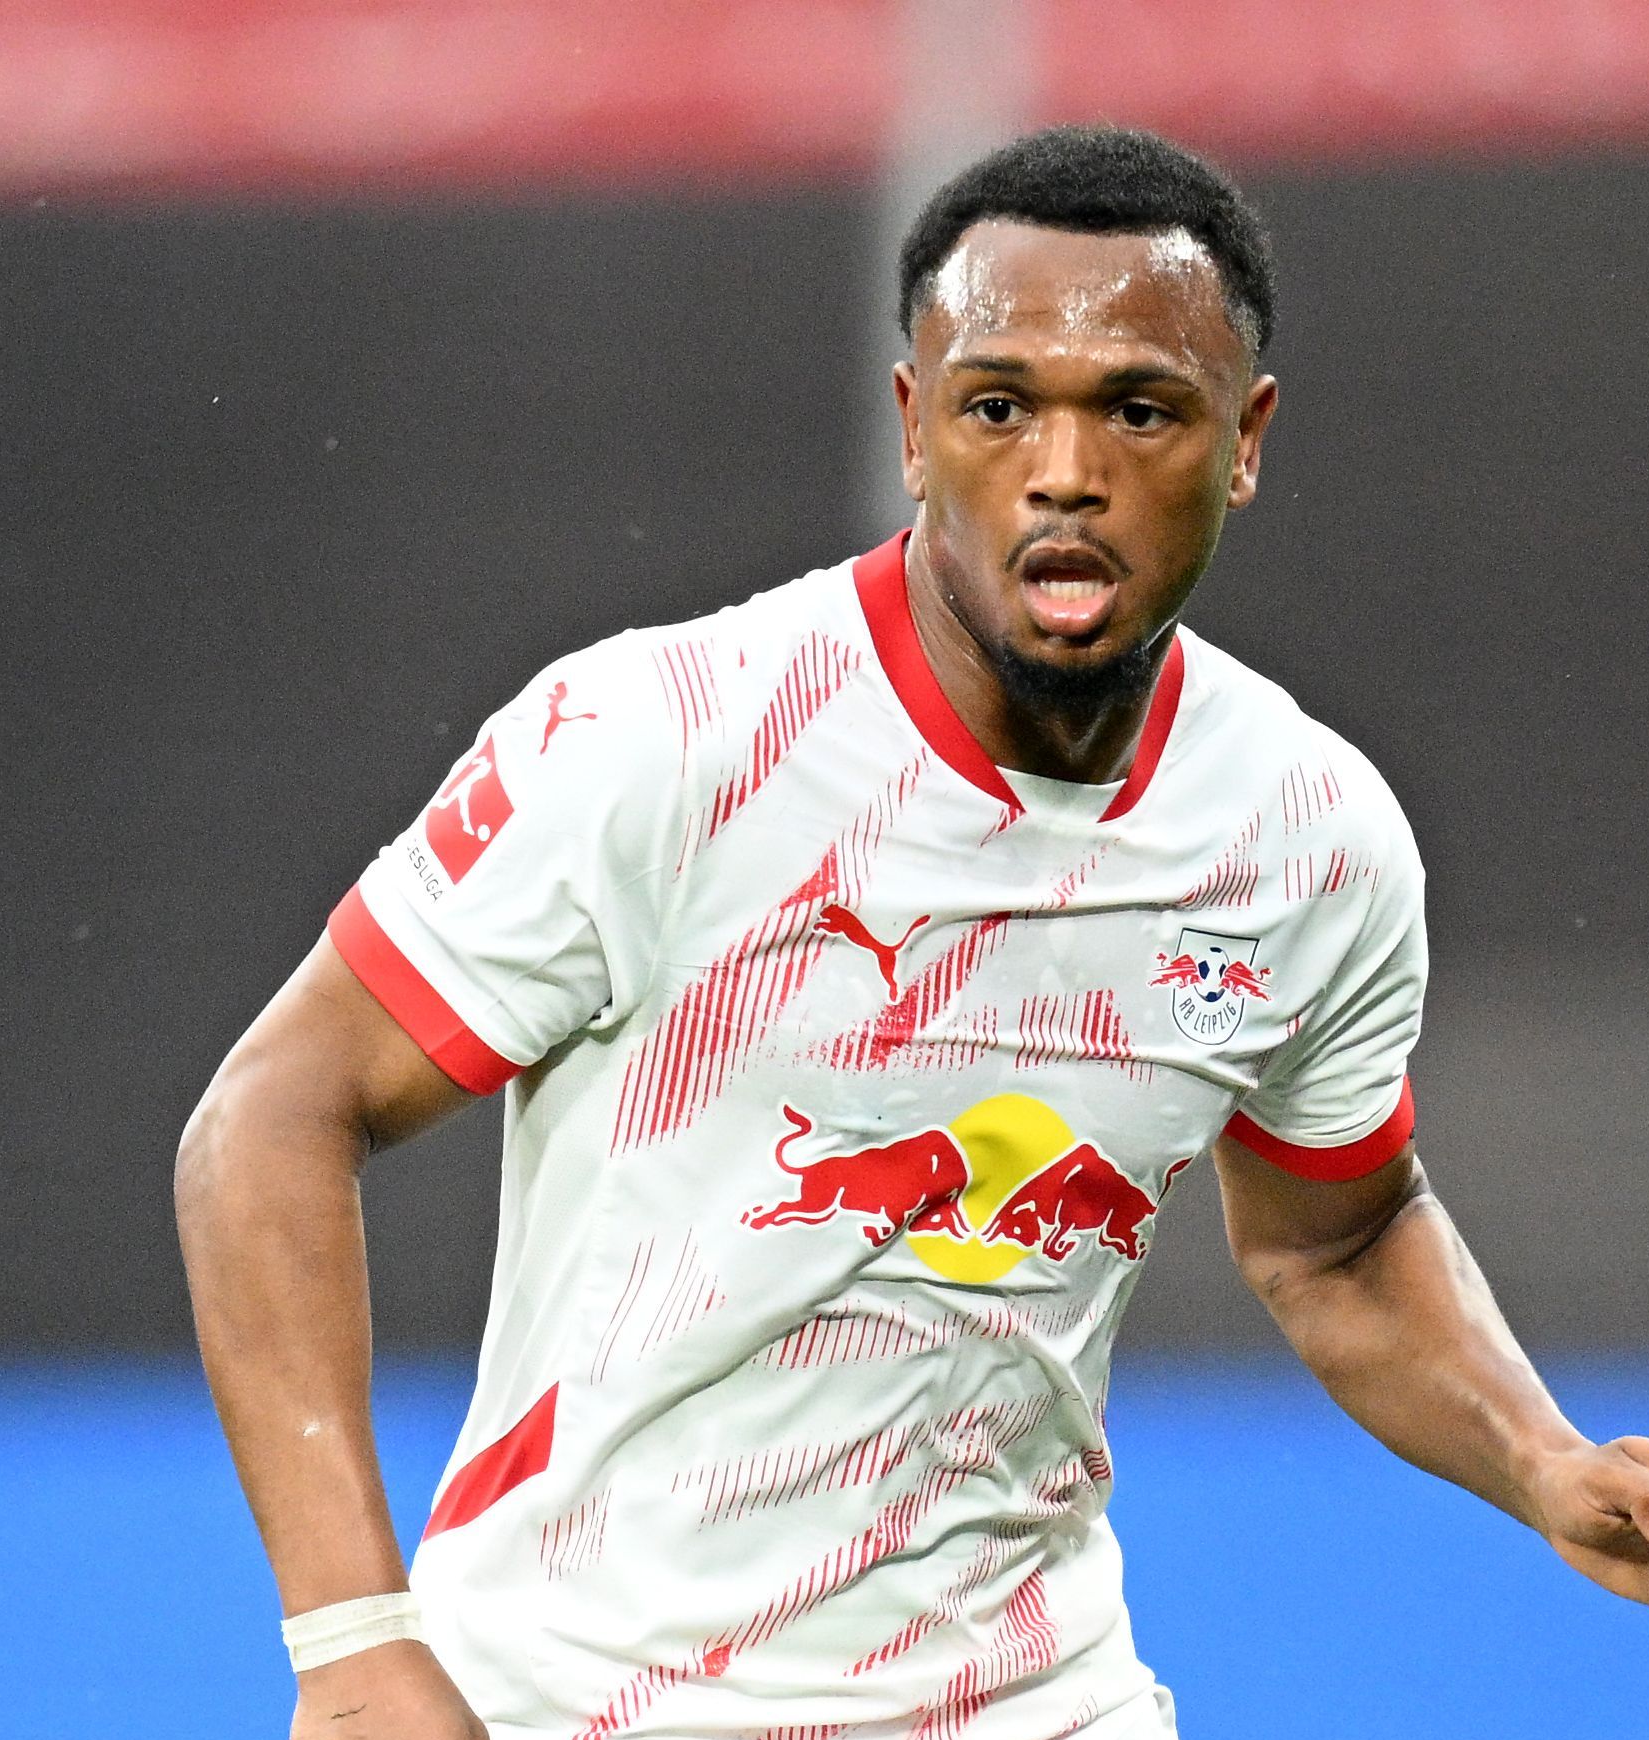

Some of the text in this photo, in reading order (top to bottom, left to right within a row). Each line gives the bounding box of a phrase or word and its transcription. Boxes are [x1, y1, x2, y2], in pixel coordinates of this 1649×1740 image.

[407, 838, 443, 901] ESLIGA
[1179, 997, 1237, 1034] RB LEIPZIG
